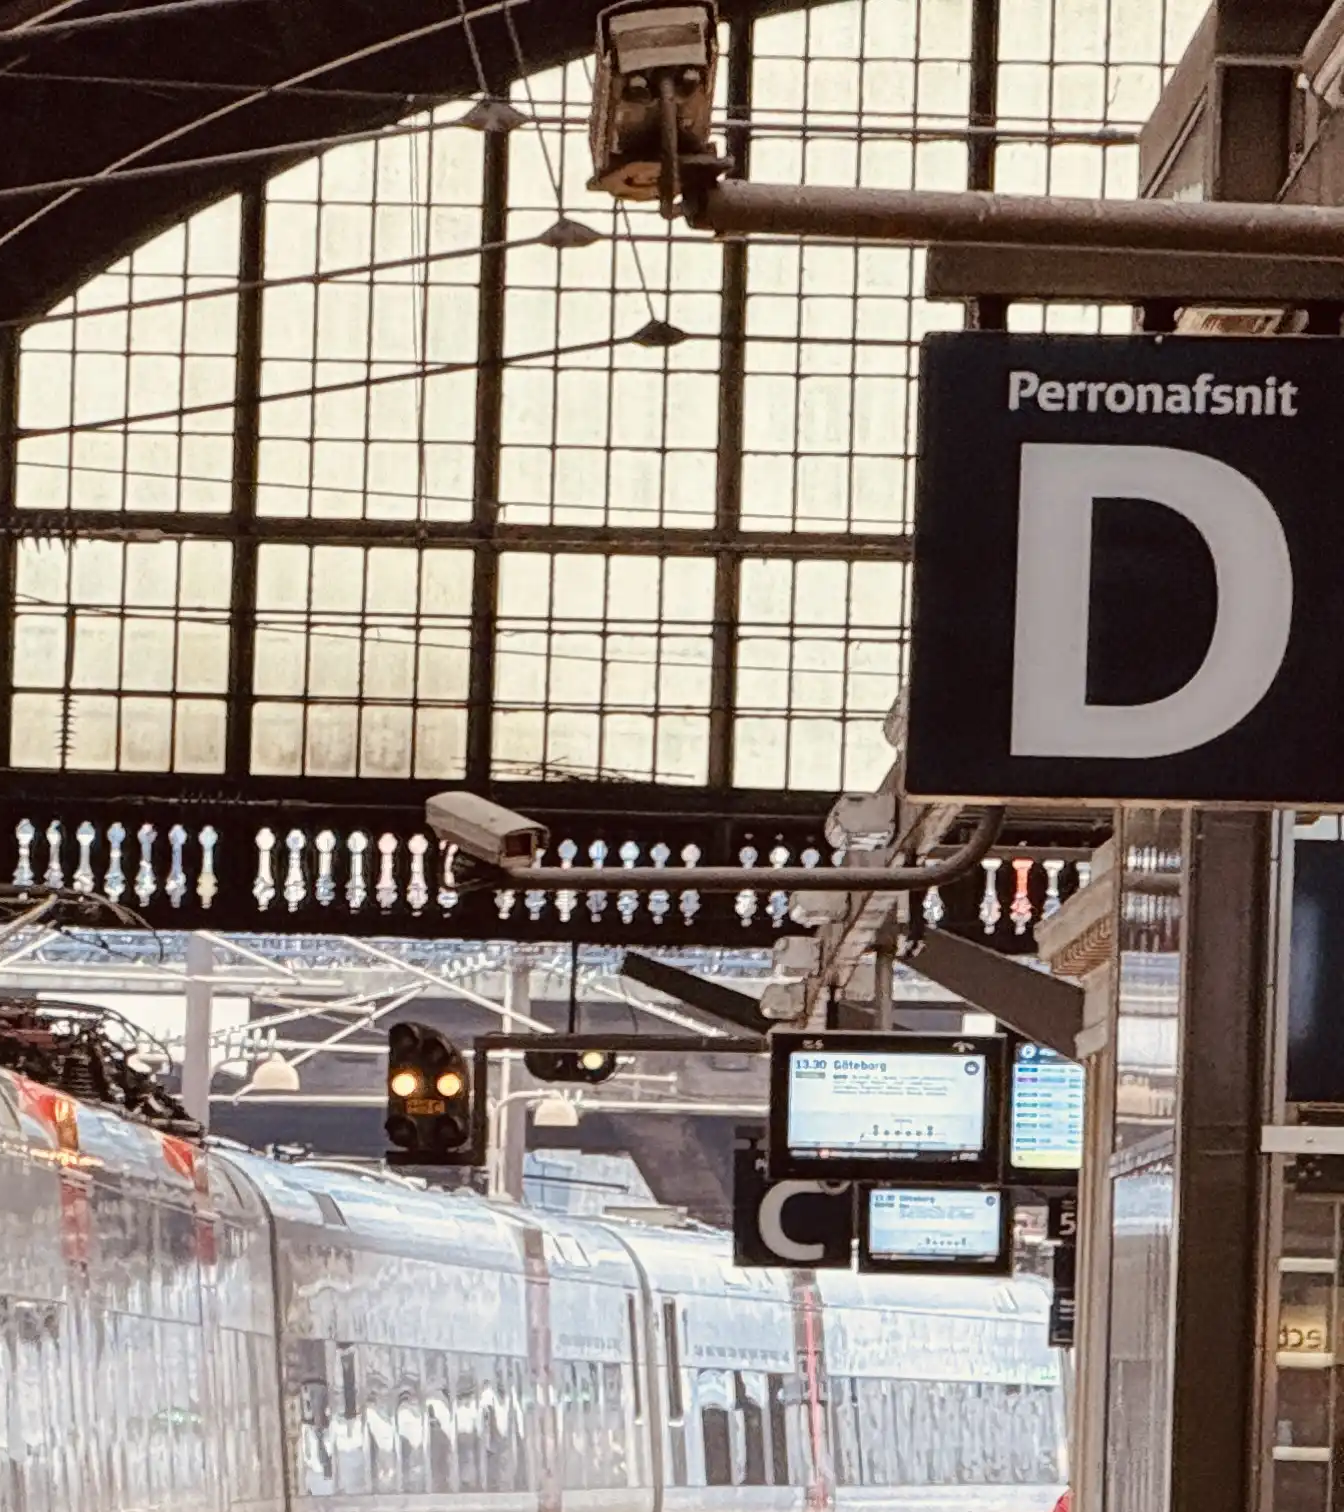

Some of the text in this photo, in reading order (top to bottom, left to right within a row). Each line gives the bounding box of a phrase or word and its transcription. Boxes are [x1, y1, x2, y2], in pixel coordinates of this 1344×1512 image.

[1007, 371, 1299, 416] Perronafsnit
[1009, 441, 1294, 759] D
[758, 1180, 825, 1261] C
